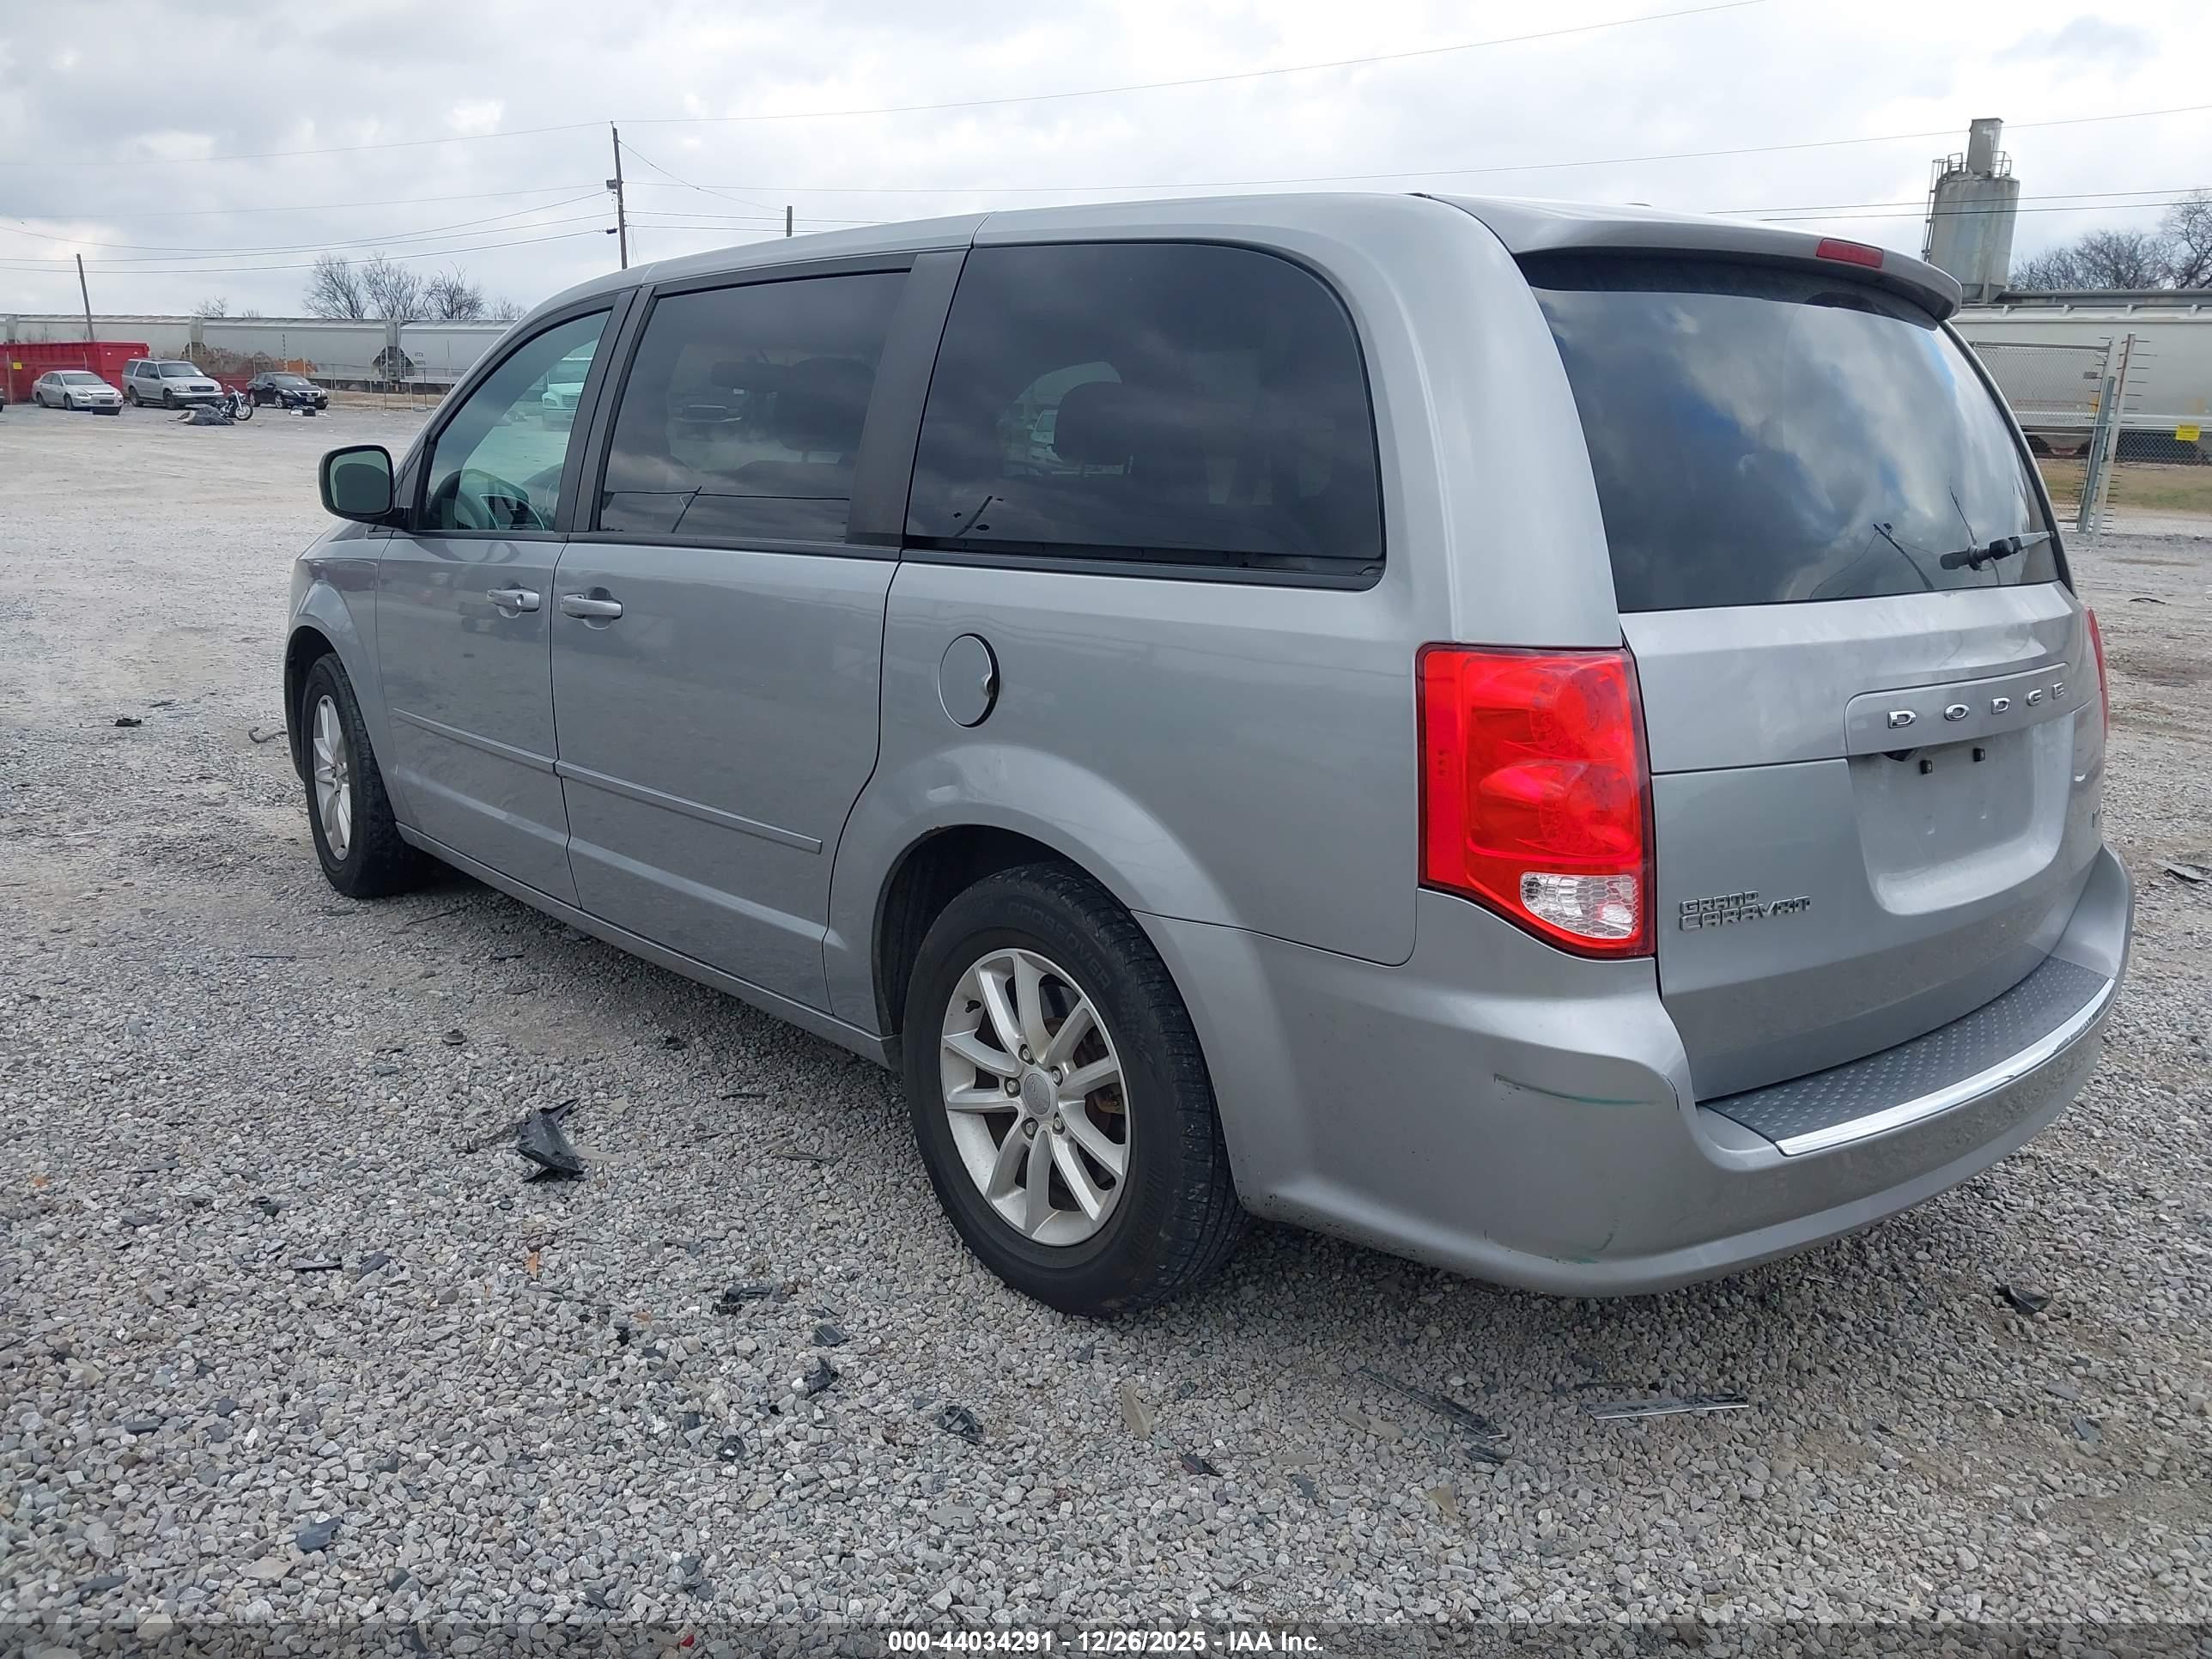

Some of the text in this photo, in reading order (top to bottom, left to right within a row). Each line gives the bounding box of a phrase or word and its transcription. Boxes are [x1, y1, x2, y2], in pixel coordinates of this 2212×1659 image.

[1887, 682, 2065, 727] DODGE
[1680, 890, 1759, 915] GRAND
[1680, 896, 1811, 932] CARAVAN
